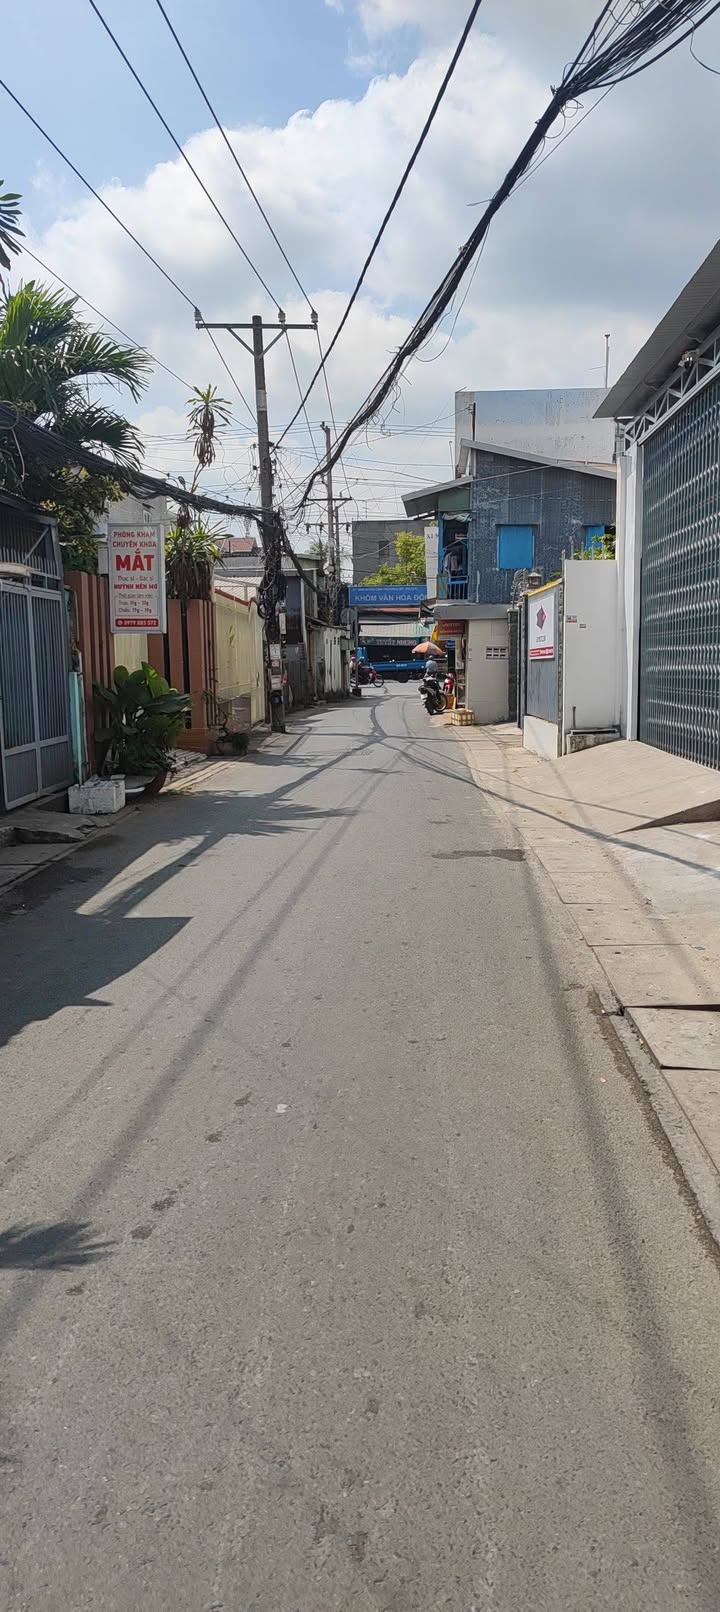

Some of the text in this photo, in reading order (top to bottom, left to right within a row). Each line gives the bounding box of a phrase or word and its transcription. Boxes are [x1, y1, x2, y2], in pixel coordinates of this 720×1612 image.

[112, 540, 138, 548] CHUYÊN
[115, 548, 155, 571] MẮT
[377, 593, 395, 601] VĂN
